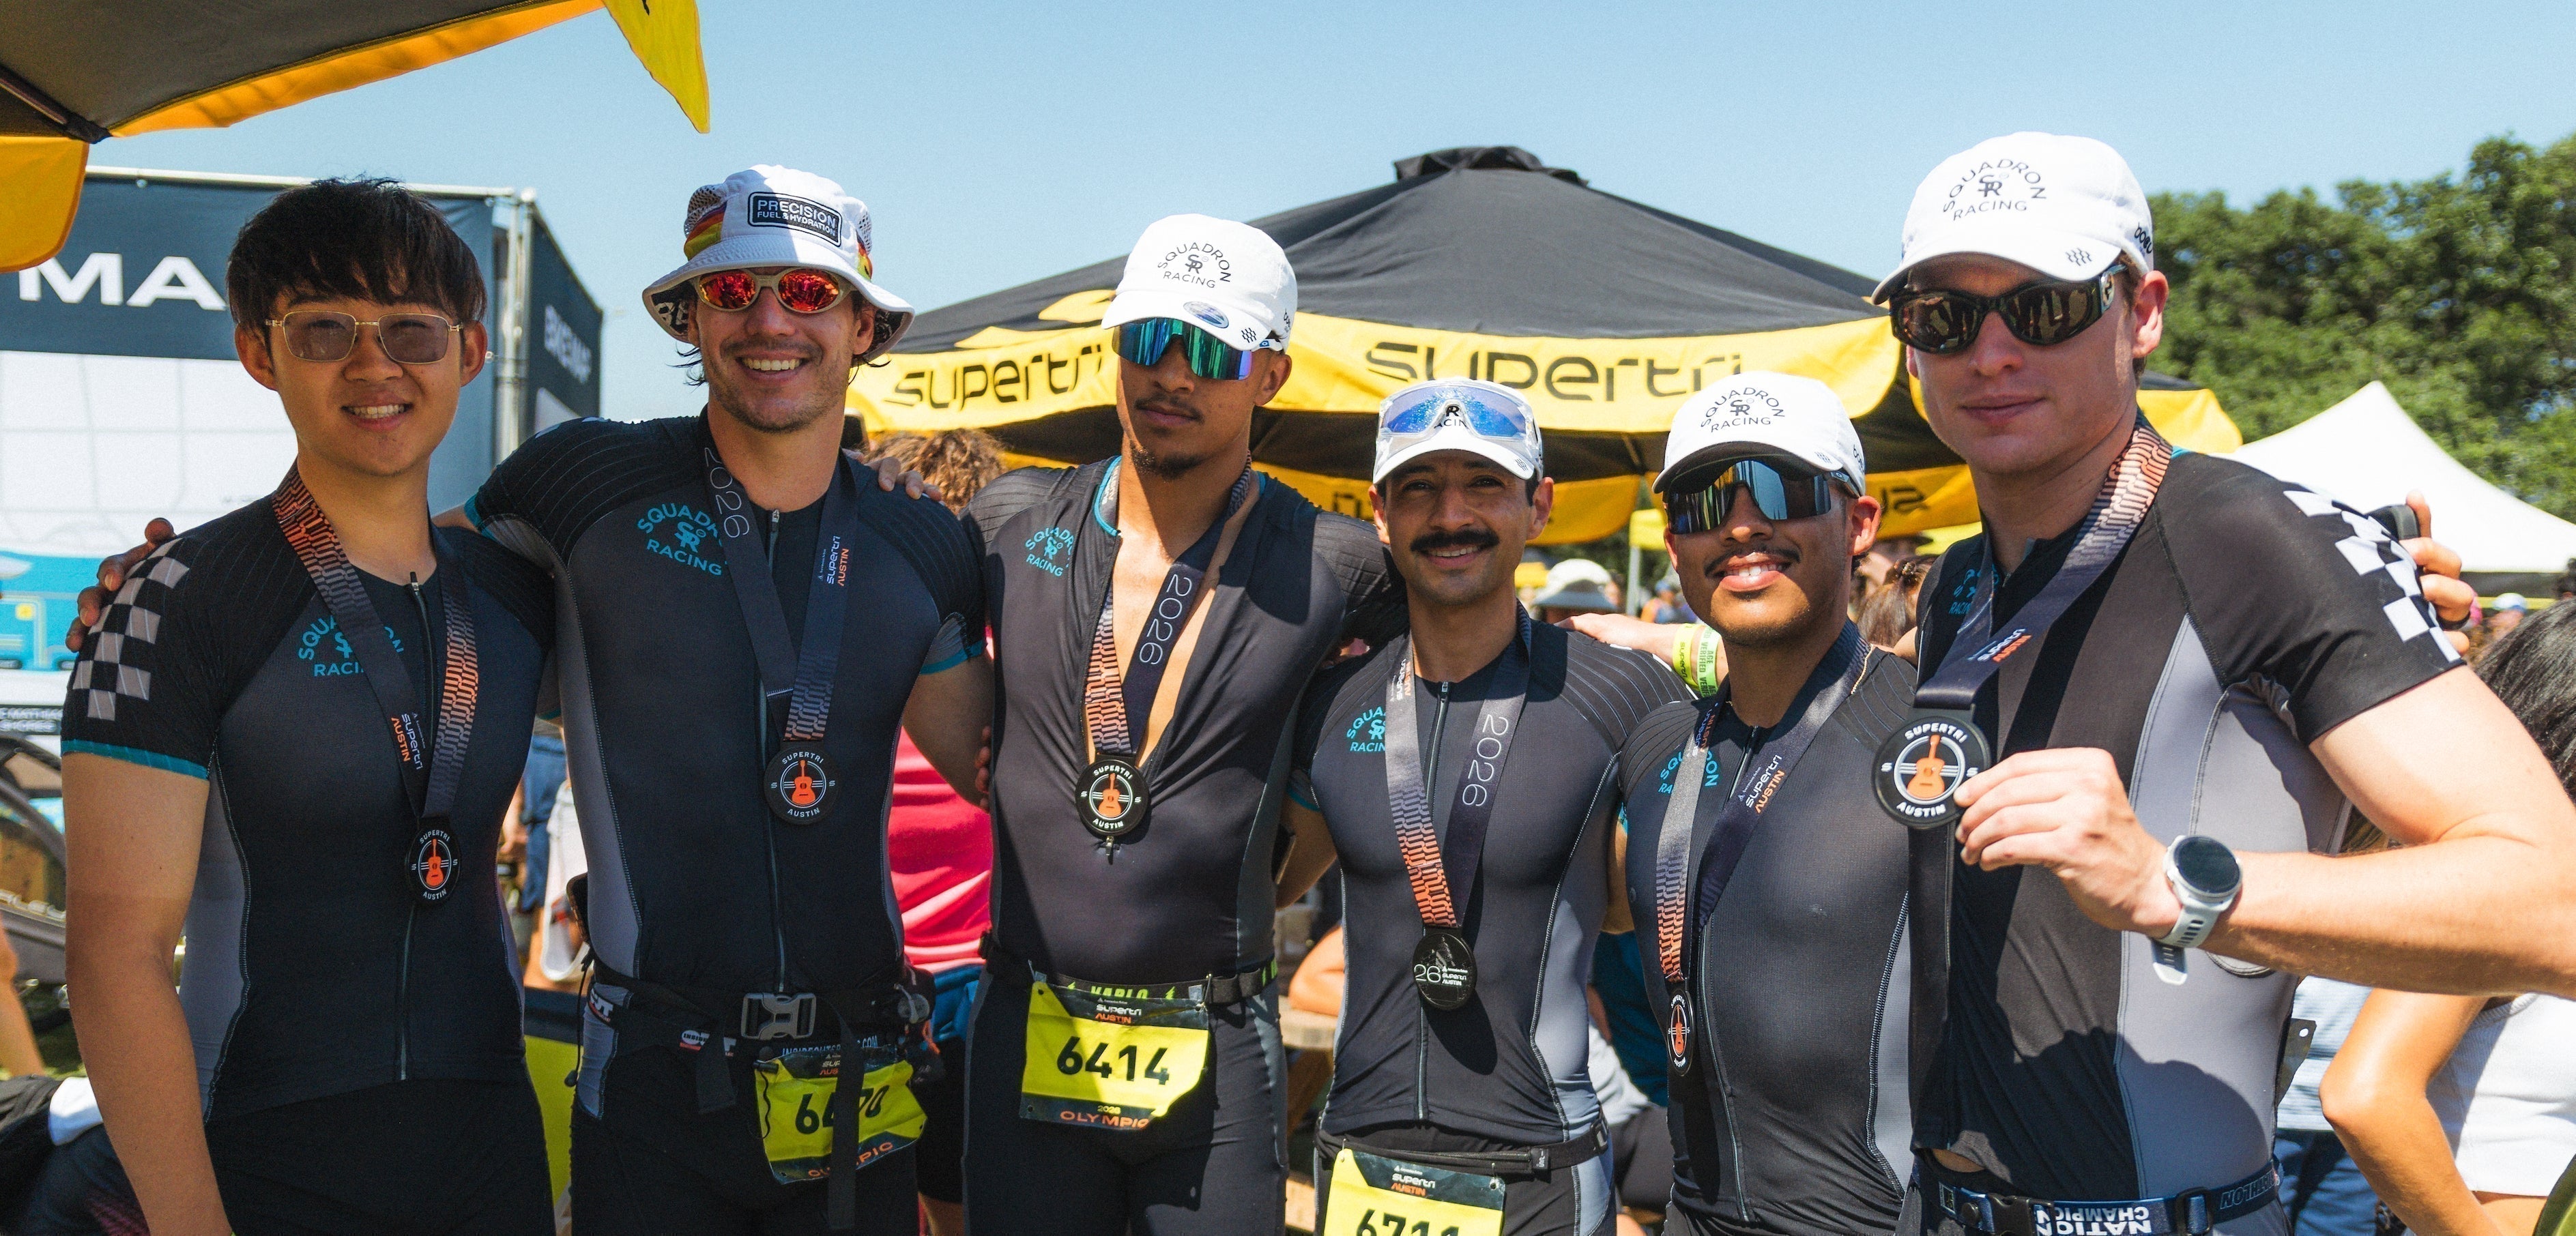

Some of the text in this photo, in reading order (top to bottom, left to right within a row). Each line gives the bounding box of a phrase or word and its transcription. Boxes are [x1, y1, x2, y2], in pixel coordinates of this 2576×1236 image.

[1943, 159, 2046, 212] SQUADRON
[757, 200, 836, 229] PRECISION
[1954, 201, 2027, 220] RACING
[790, 216, 835, 236] HYDRATION
[1157, 242, 1232, 282] SQUADRON
[1163, 271, 1215, 288] RACING
[1701, 387, 1785, 427] SQUADRON
[1711, 417, 1771, 432] RACING
[704, 447, 750, 538] 2026
[637, 503, 721, 542] SQUADR
[1025, 527, 1074, 557] SQUADR
[646, 538, 722, 576] RACING
[837, 548, 850, 587] AUSTIN
[1026, 554, 1063, 576] RACING
[1140, 574, 1192, 665] 2026
[1699, 642, 1708, 673] VERIFIED
[314, 662, 364, 677] RACI
[1346, 707, 1386, 739] SQUA
[1905, 722, 1968, 743] SUPERTRI
[391, 718, 411, 762] AUSTIN
[1350, 742, 1386, 752] RACIN
[782, 751, 824, 765] SUPERTRI
[1462, 714, 1509, 806] 2026
[1093, 765, 1133, 779] SUPERTRI
[1754, 769, 1786, 814] AUSTIN
[787, 808, 820, 817] AUSTIN
[1896, 801, 1946, 817] AUSTIN
[1092, 819, 1124, 829] AUSTIN
[420, 829, 450, 844] SUPERTRI
[423, 889, 447, 900] AUSTIN
[1414, 964, 1441, 983] 26
[1095, 1012, 1132, 1023] AUSTIN
[1057, 1036, 1170, 1085] 6414
[1060, 1110, 1150, 1128] OLYMPIC
[1391, 1182, 1426, 1196] AUSTIN
